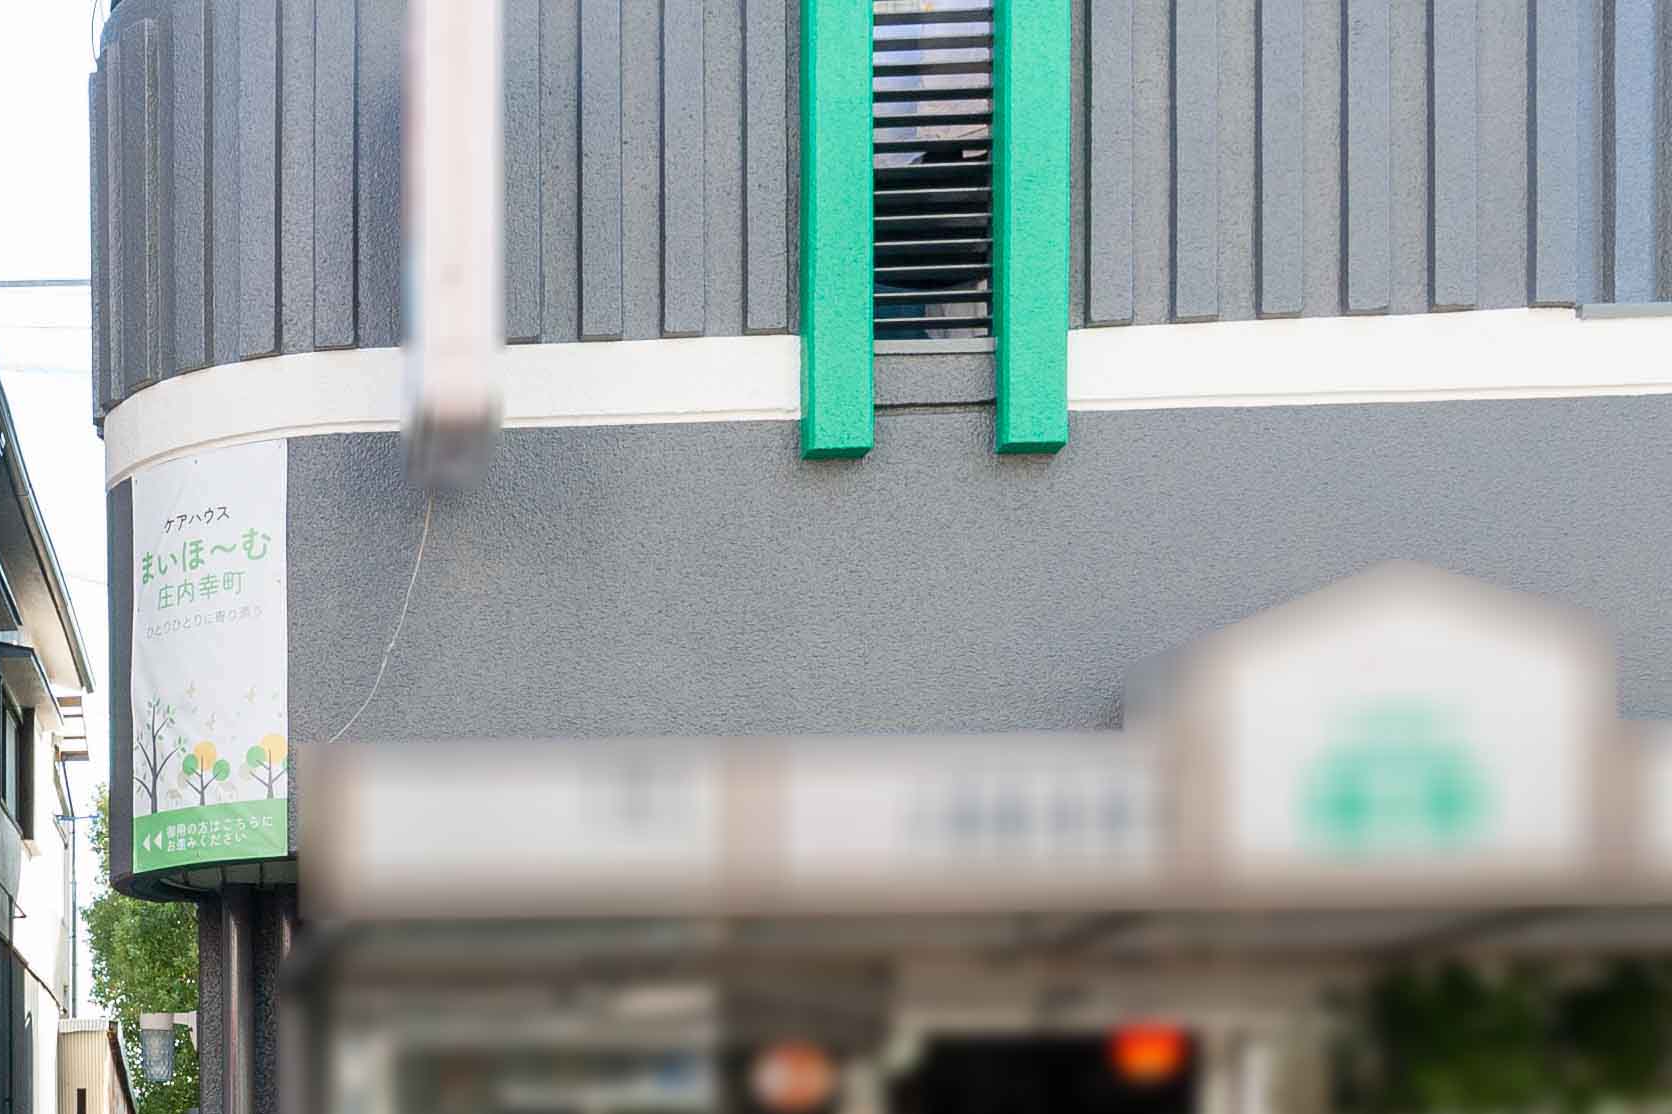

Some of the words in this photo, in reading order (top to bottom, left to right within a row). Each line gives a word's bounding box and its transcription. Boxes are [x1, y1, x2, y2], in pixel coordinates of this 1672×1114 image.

[164, 506, 231, 533] ケアハウス
[158, 570, 246, 610] 庄内幸町
